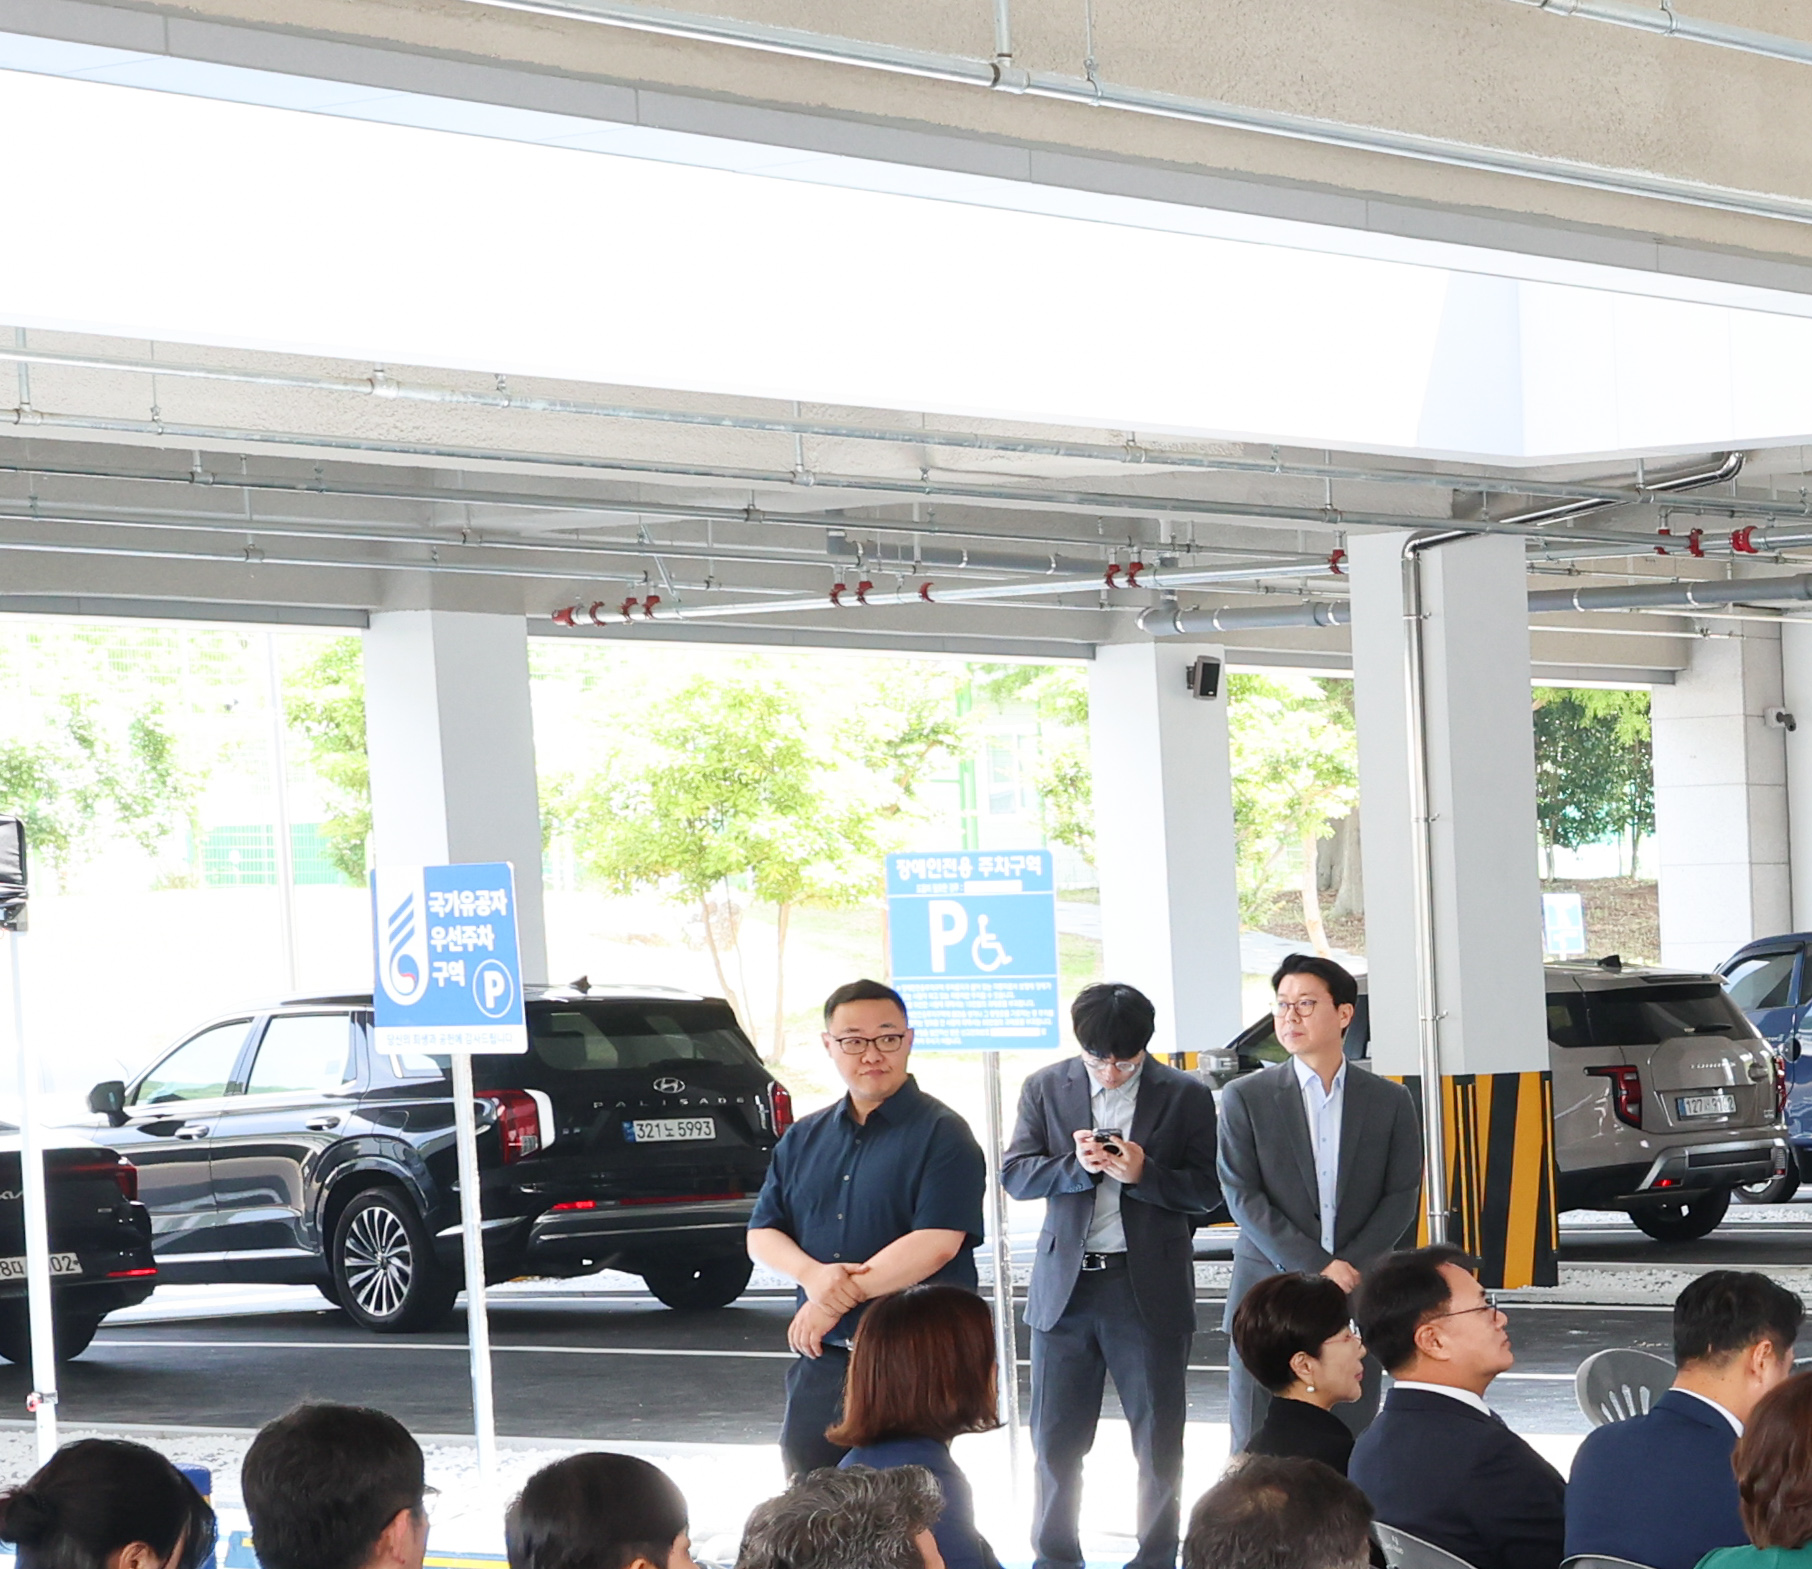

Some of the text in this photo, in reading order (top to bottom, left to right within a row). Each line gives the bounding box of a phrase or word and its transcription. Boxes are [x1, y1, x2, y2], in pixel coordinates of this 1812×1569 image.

[896, 855, 1042, 881] 장애인전용 주차구역
[428, 888, 508, 918] 국가유공자
[430, 924, 495, 952] 우선주차
[928, 900, 968, 973] P
[432, 959, 465, 987] 구역
[483, 970, 505, 1009] P
